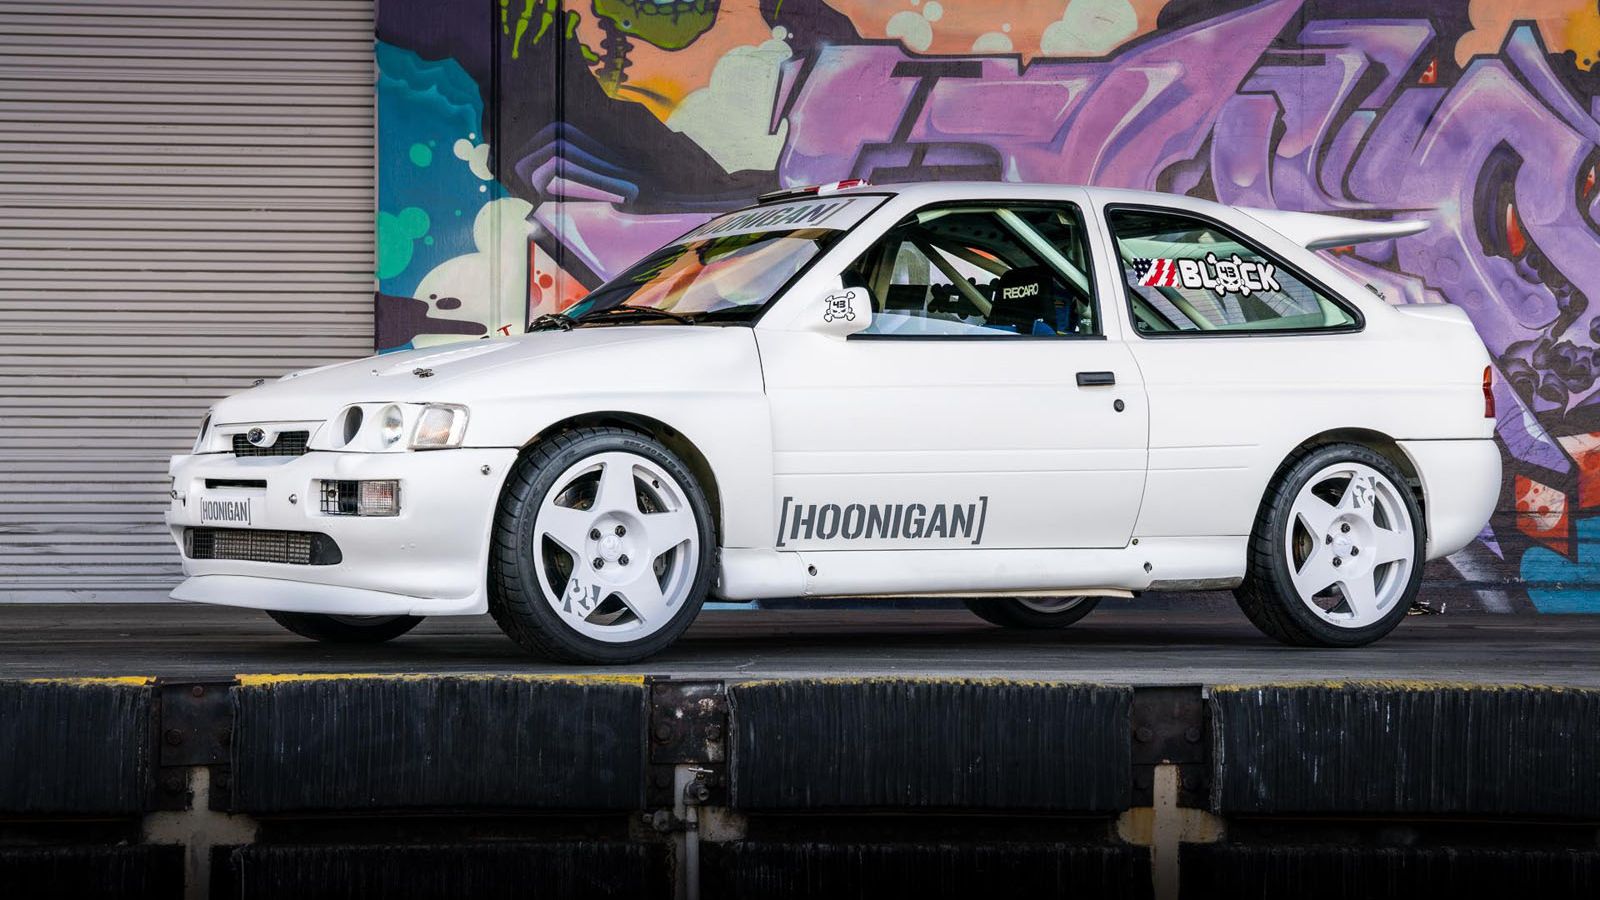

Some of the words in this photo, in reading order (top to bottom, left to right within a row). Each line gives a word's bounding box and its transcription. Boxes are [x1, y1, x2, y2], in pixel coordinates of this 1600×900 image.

[1219, 266, 1236, 278] 43
[1003, 282, 1039, 300] RECARO
[832, 300, 846, 309] 43
